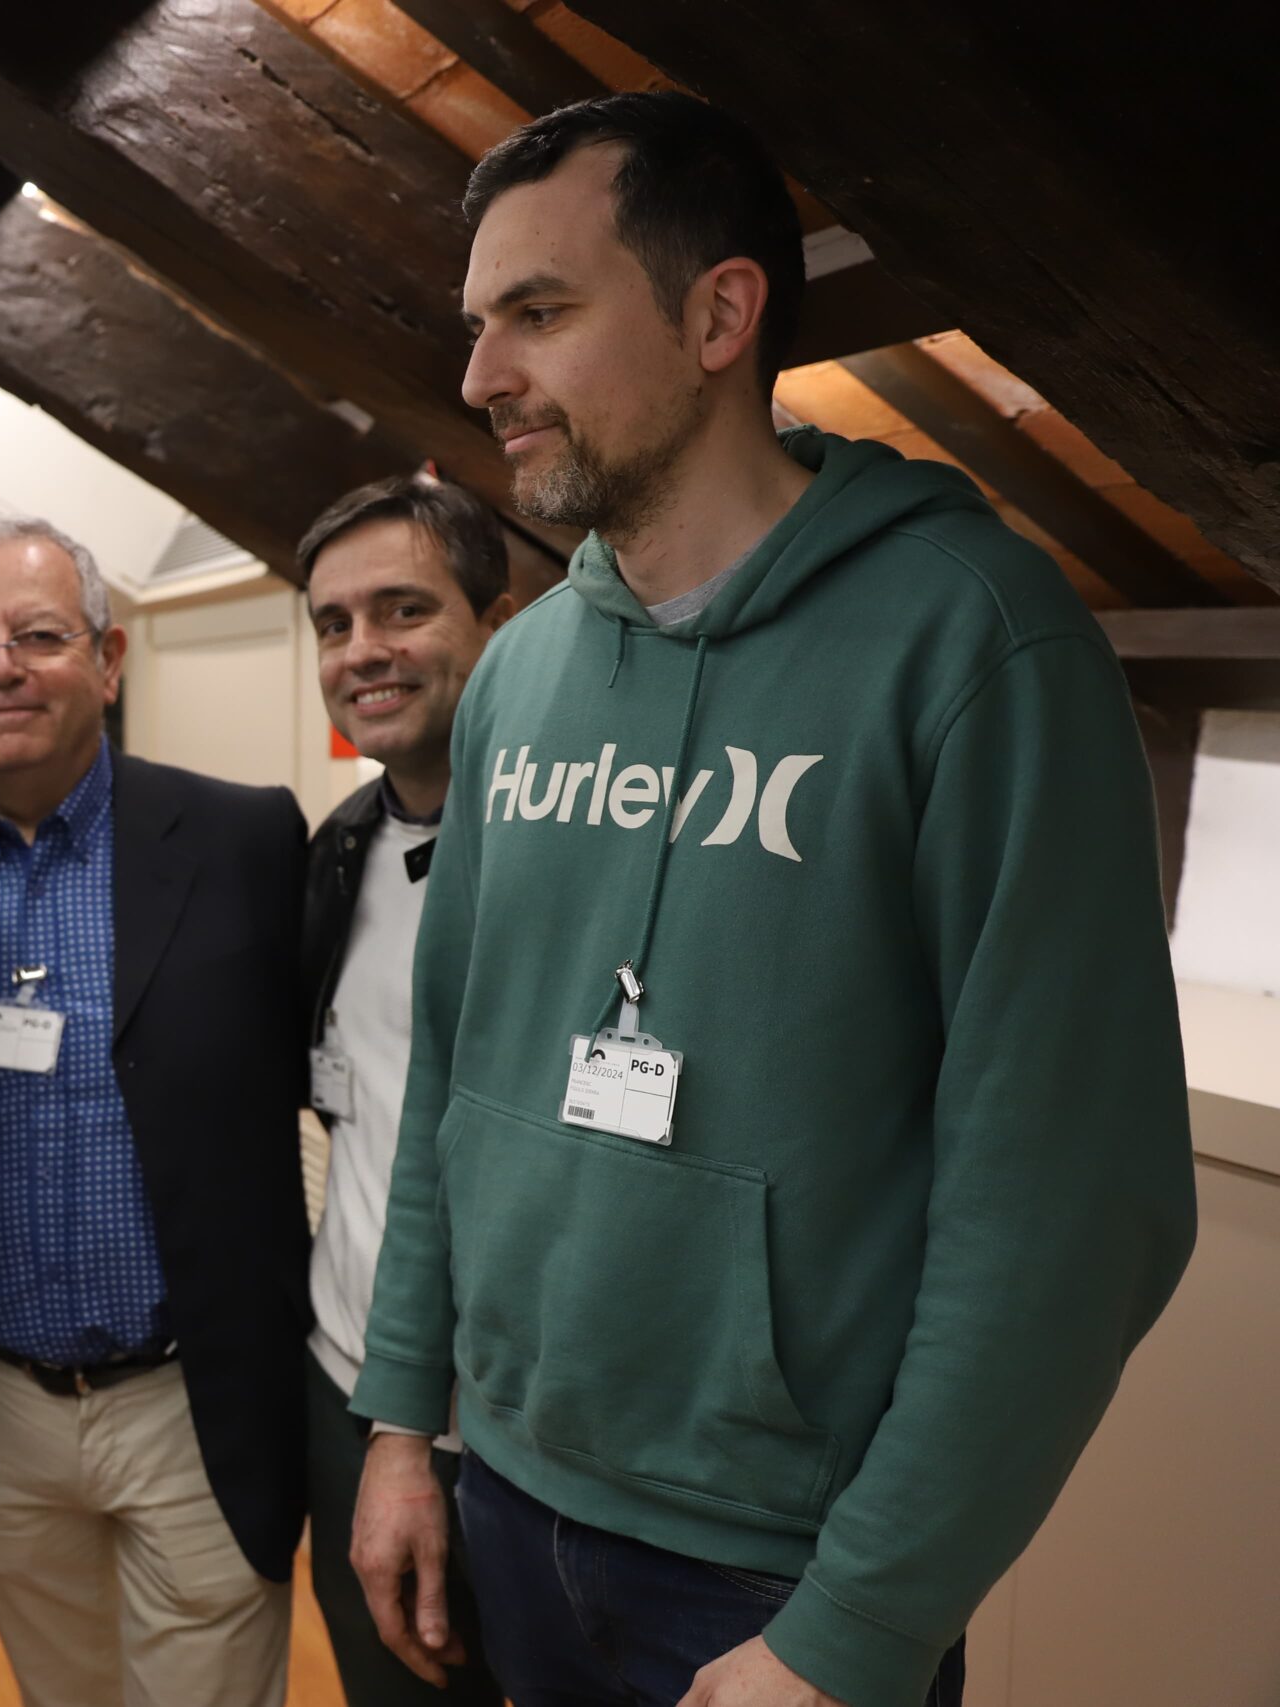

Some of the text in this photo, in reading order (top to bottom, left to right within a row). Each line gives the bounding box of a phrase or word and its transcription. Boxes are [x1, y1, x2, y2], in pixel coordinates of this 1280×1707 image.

[485, 743, 714, 844] Hurley
[572, 1062, 624, 1081] 03/12/2024
[630, 1059, 665, 1077] PG-D
